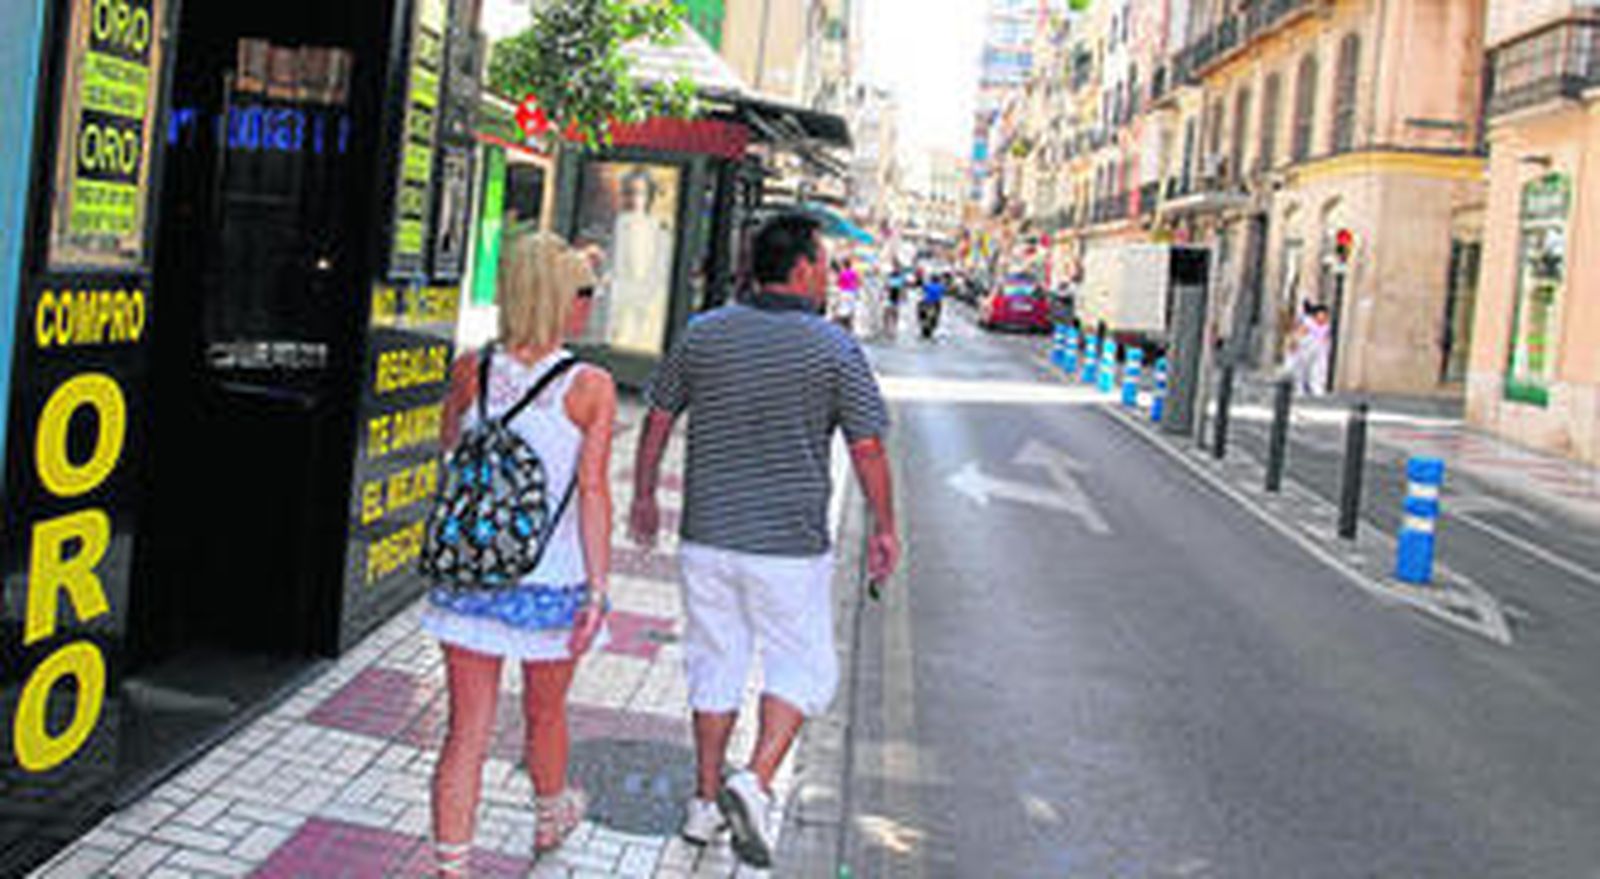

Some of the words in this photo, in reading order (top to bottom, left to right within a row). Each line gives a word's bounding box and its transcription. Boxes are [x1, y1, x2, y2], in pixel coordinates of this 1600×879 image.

[93, 0, 150, 50] ORO
[80, 123, 138, 174] ORO
[35, 290, 146, 346] COMPRO
[367, 413, 390, 457] TE
[361, 480, 384, 525] EL
[14, 371, 128, 771] ORO
